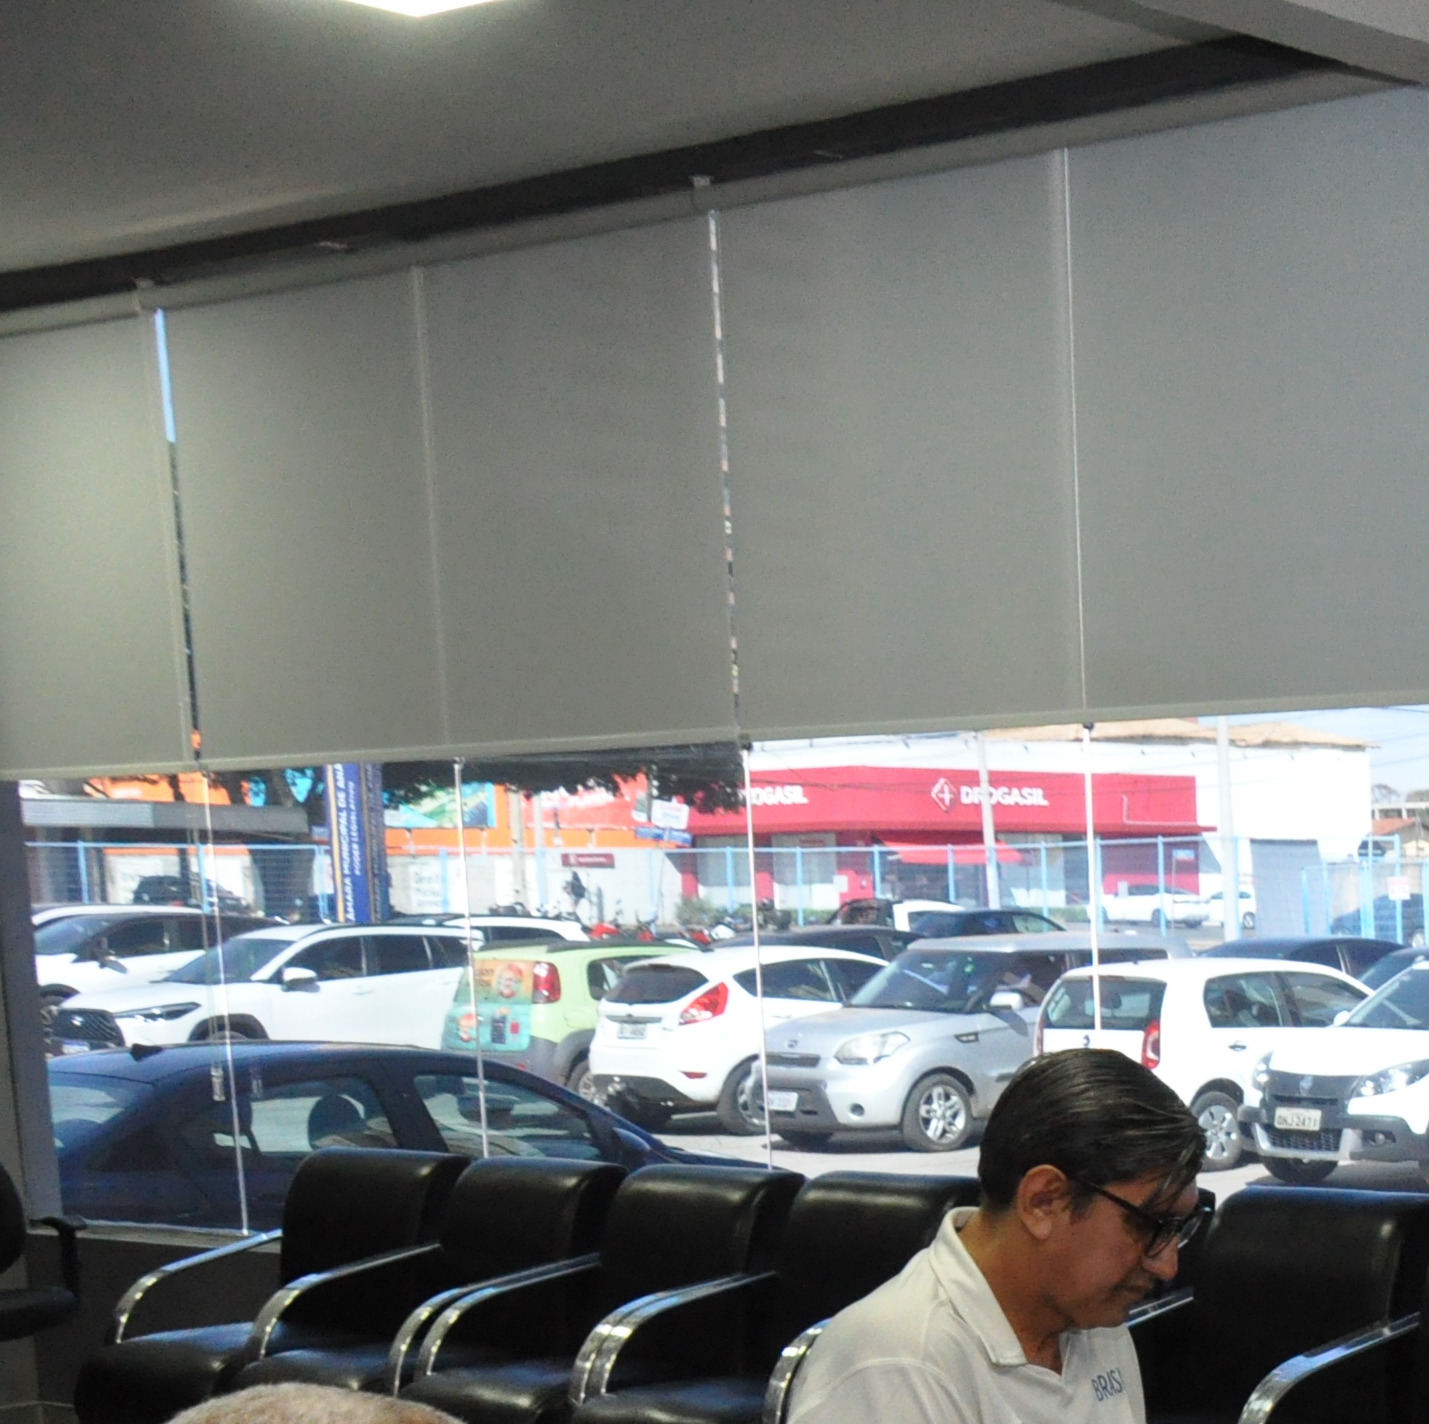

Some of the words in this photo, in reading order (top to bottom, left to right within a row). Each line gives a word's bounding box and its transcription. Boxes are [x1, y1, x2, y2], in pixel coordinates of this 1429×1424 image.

[336, 790, 347, 808] DE
[738, 785, 809, 806] OGASIL
[960, 785, 1050, 807] DROGASIL
[338, 809, 351, 875] MUNICIPAL
[344, 876, 356, 923] ÂMARA
